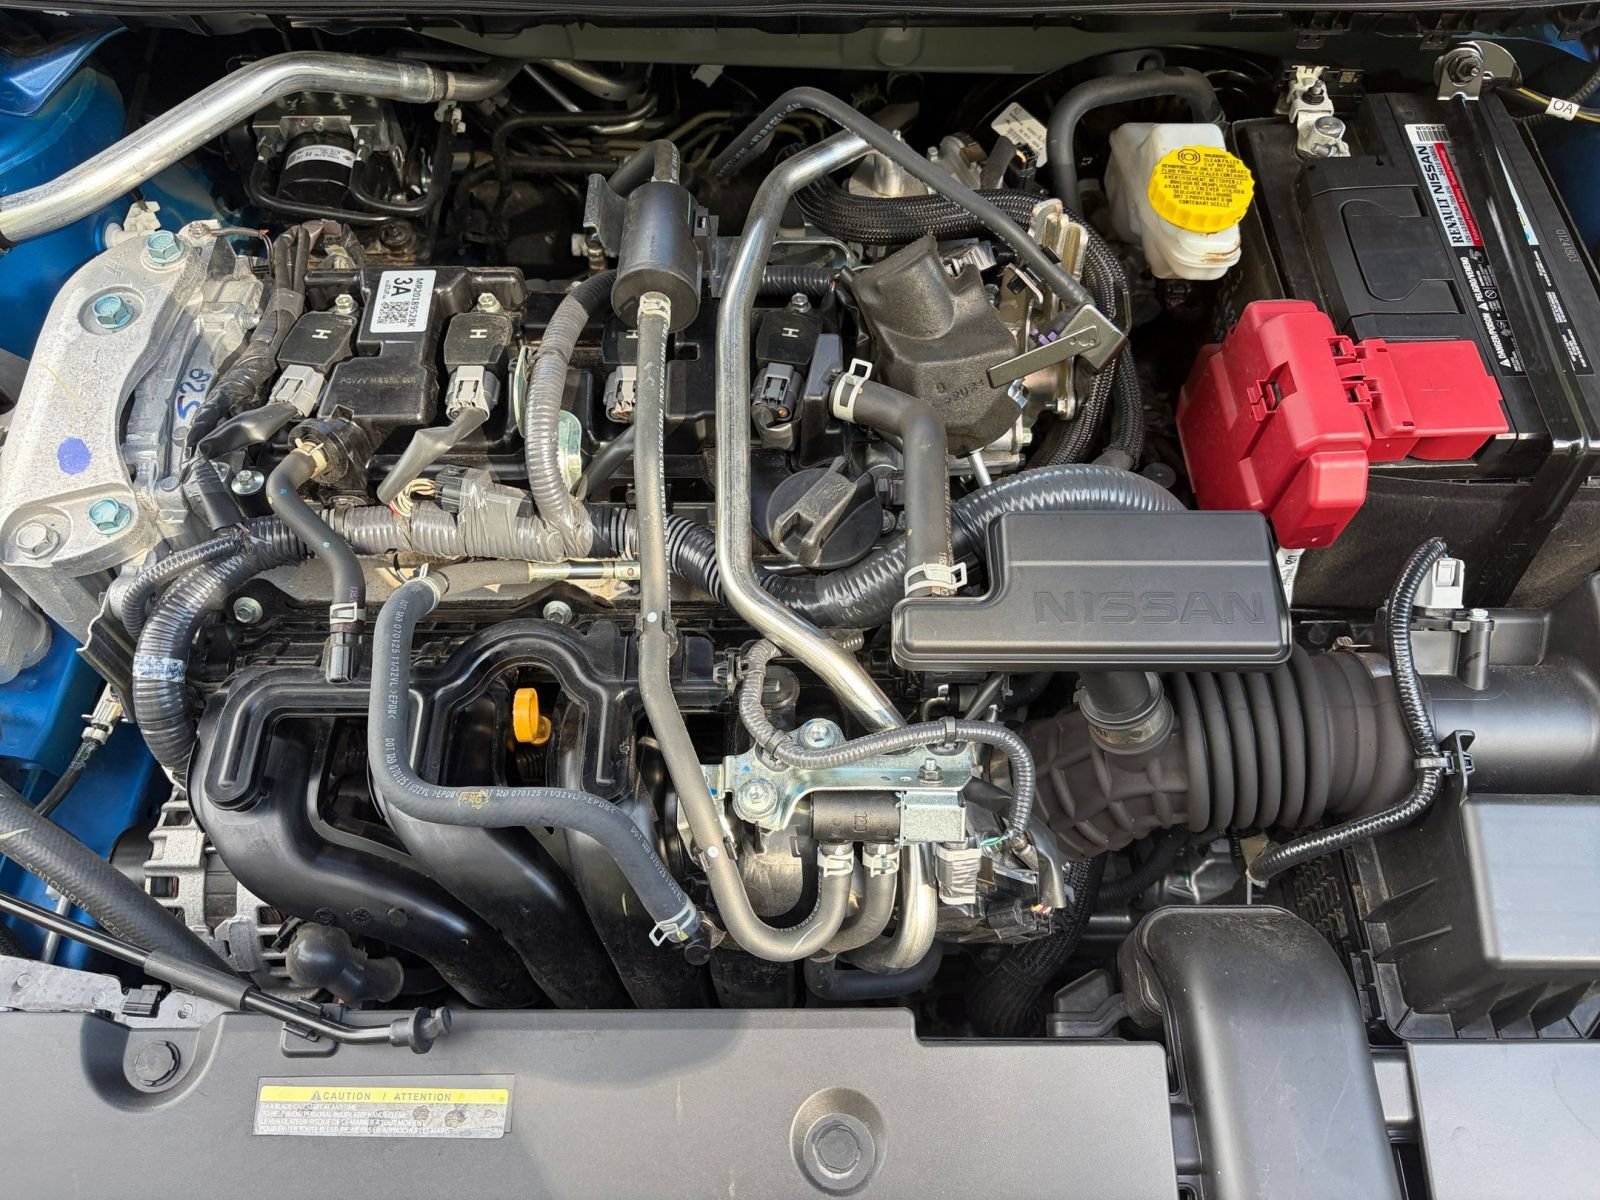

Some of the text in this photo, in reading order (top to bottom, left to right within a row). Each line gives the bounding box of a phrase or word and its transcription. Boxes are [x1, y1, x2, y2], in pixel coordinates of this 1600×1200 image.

[1554, 100, 1573, 114] OA
[1416, 146, 1444, 194] NISSAN
[1436, 198, 1464, 244] RENAULT
[391, 278, 413, 296] 3A
[1033, 591, 1265, 624] NISSAN
[392, 624, 402, 653] 070125
[511, 788, 542, 797] 070125
[323, 1092, 371, 1100] CAUTION
[394, 1092, 452, 1101] ATTENTION
